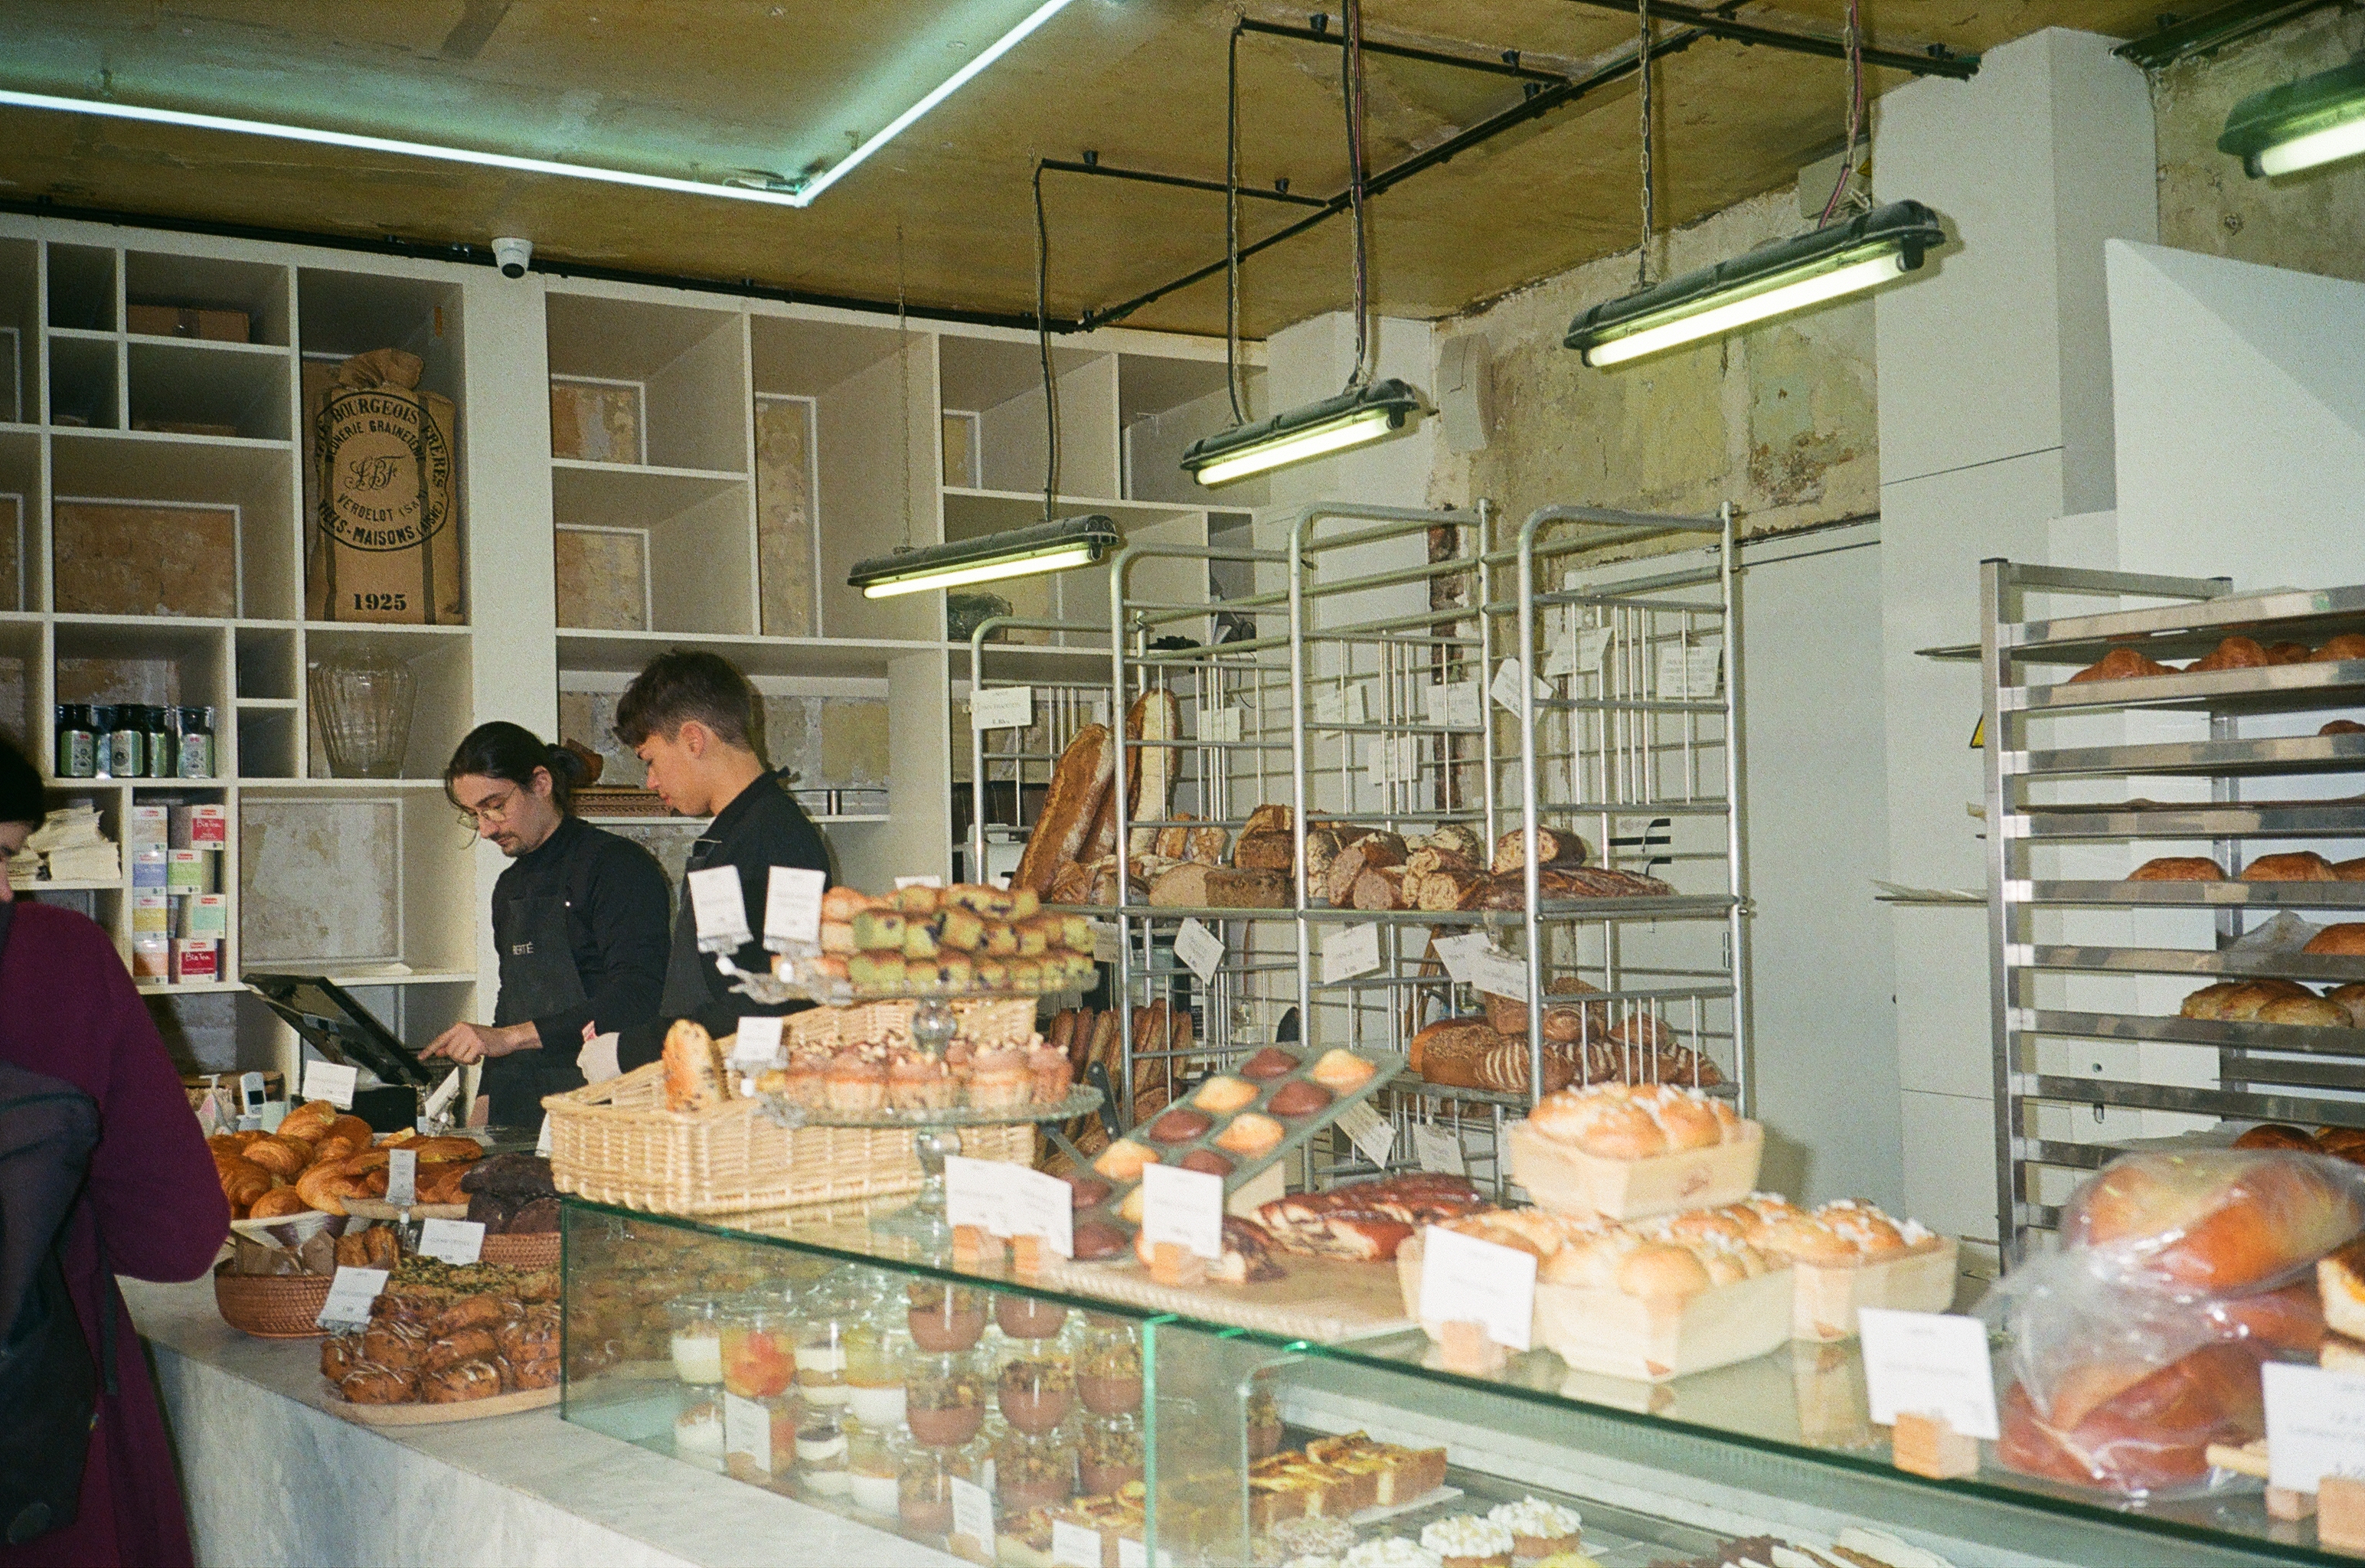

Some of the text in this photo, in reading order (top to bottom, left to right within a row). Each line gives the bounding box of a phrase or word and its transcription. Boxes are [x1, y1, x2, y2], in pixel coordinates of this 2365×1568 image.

[331, 397, 419, 424] BOURGEOIS
[337, 492, 394, 522] VERDELOT
[353, 593, 407, 611] 1925
